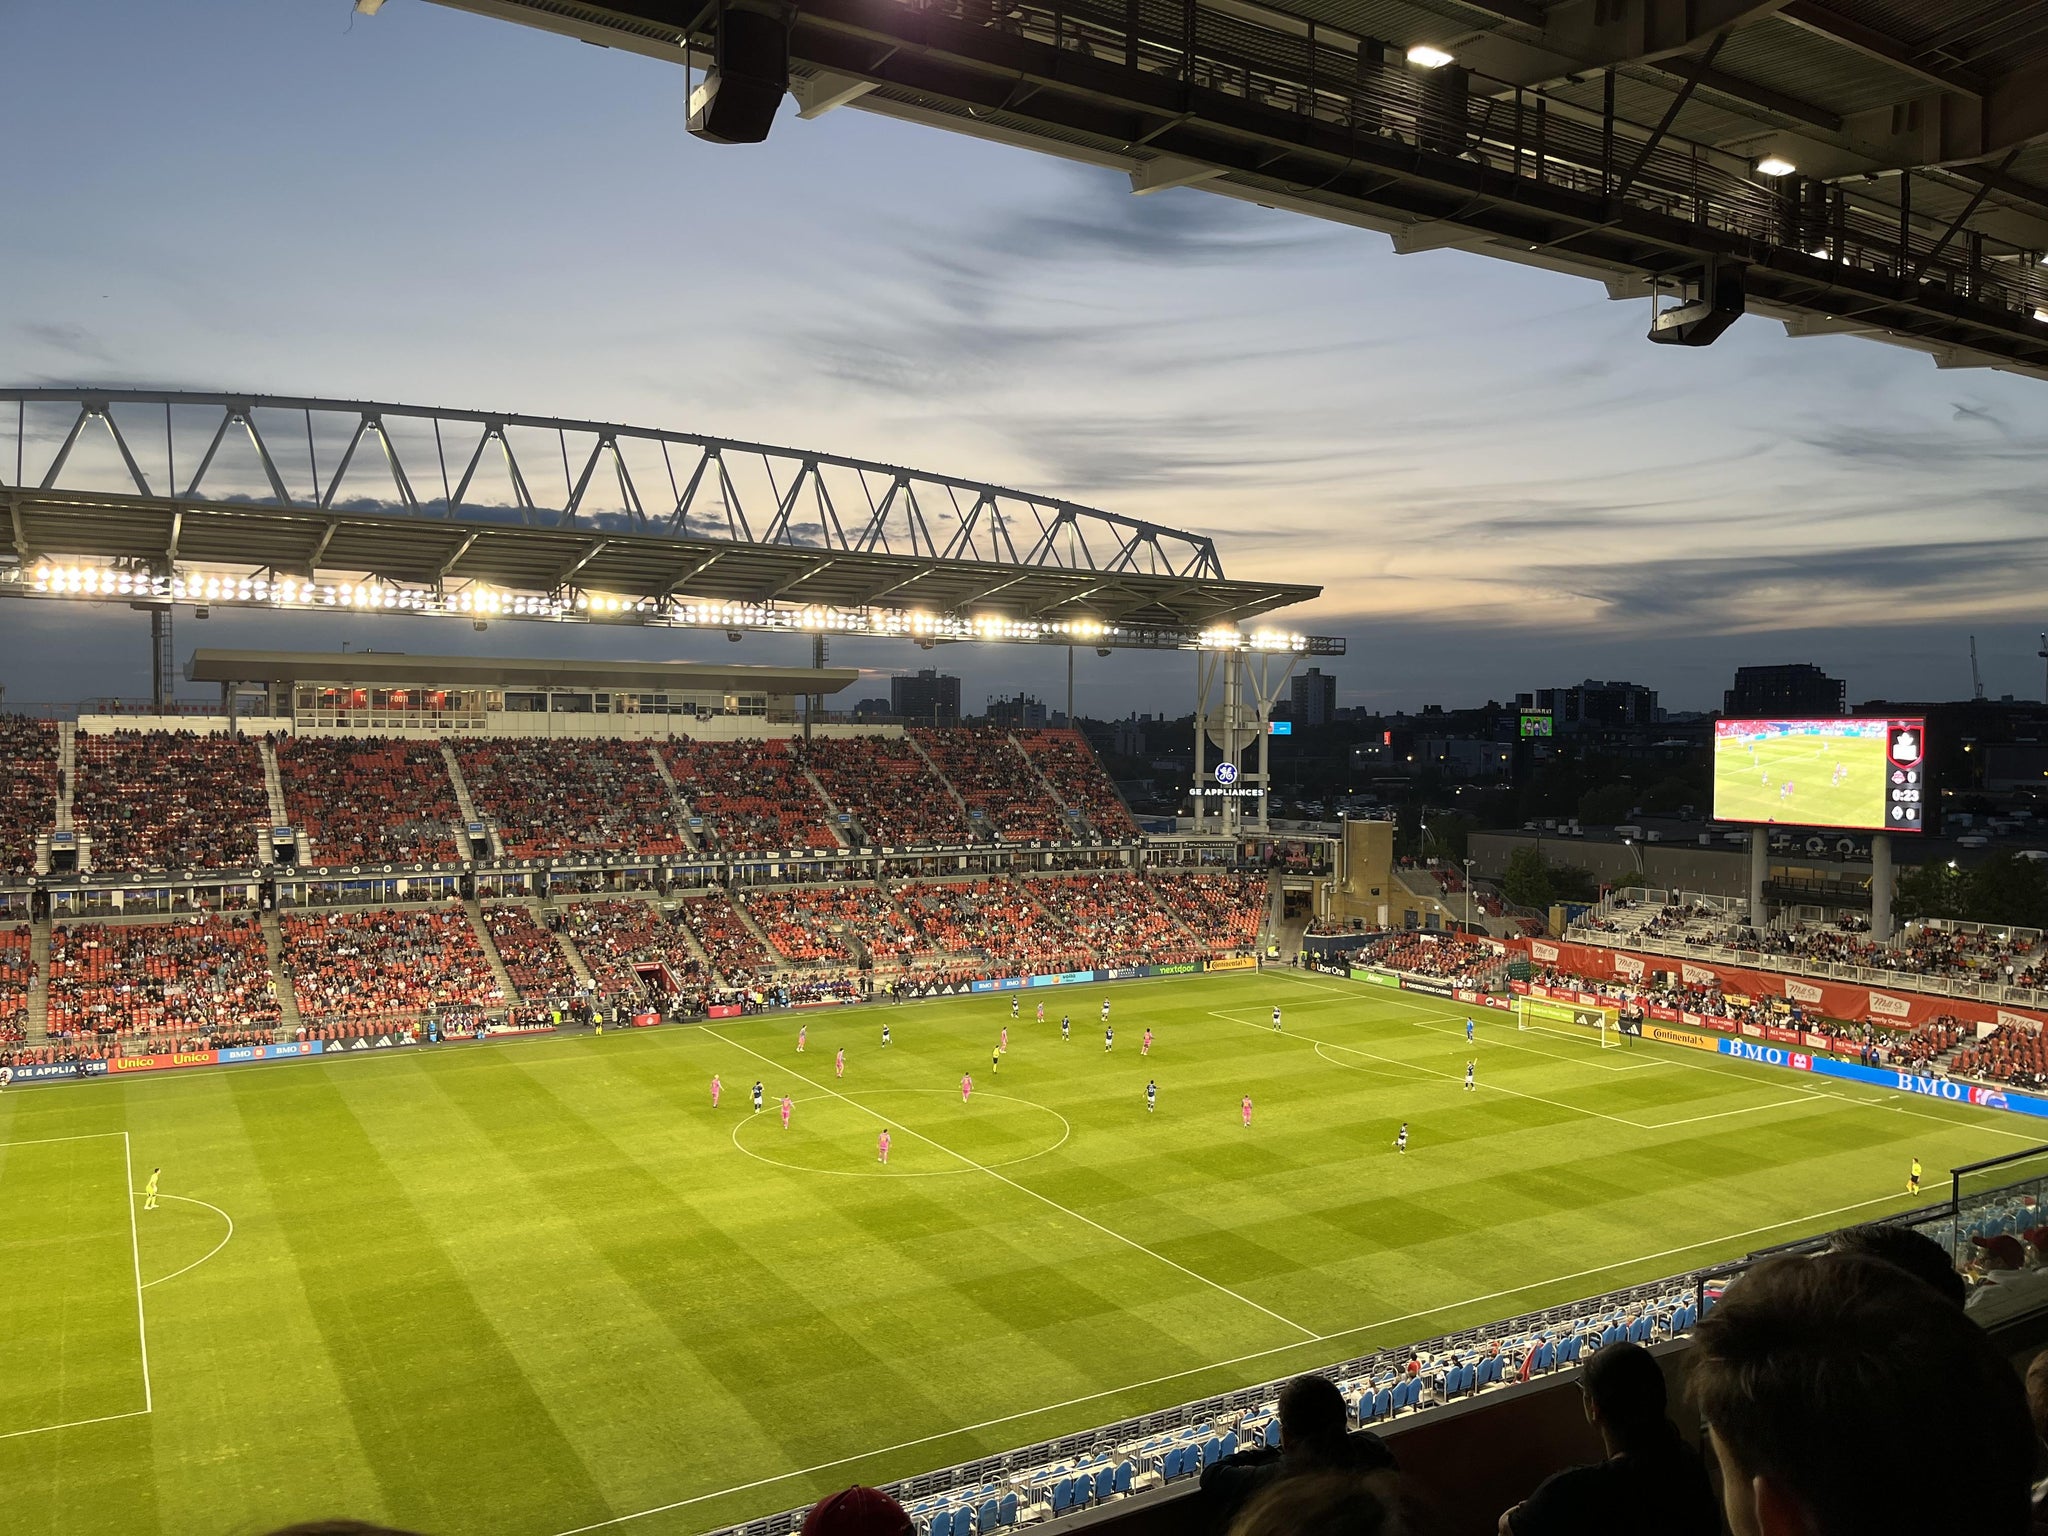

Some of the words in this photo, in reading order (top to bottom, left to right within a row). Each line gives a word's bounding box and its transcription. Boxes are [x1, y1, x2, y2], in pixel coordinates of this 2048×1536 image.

[1189, 788, 1202, 796] GE
[1204, 788, 1264, 796] APPLIANCES
[1892, 789, 1920, 802] 0:23
[1160, 964, 1194, 974] nextdoor
[1212, 960, 1243, 969] Continental
[1316, 963, 1331, 974] Uber
[1332, 966, 1346, 976] One
[1788, 984, 1807, 994] Mill
[1872, 996, 1894, 1008] Mill
[1888, 1018, 1912, 1027] Organic
[1654, 1028, 1698, 1044] Continental
[230, 1050, 251, 1058] BMO
[276, 1046, 297, 1054] BMO
[1729, 1040, 1782, 1064] BMO
[117, 1058, 154, 1070] Unico
[173, 1054, 210, 1065] Unico
[18, 1069, 32, 1077] GE
[34, 1062, 107, 1076] APPLIACES
[1896, 1073, 1960, 1100] BMO
